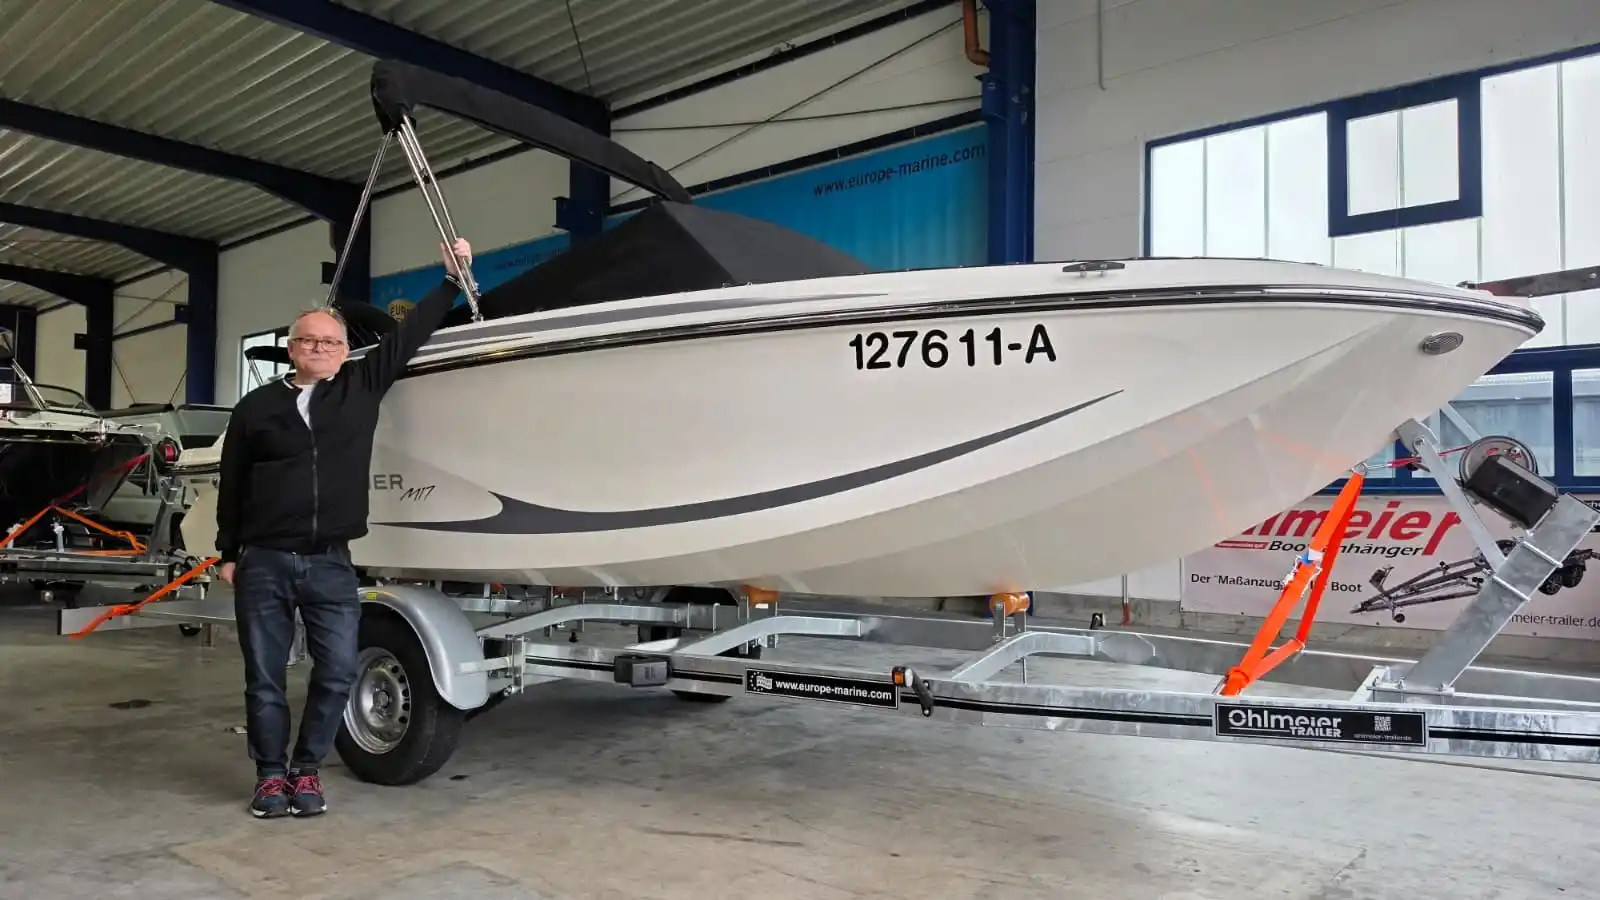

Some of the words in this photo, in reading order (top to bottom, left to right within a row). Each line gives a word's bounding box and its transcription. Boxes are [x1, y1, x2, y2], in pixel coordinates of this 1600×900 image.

[813, 143, 986, 196] www.europe-marine.com
[1191, 573, 1211, 584] Der
[1331, 581, 1362, 593] Boot
[775, 680, 892, 700] www.europe-marine.com
[1228, 709, 1342, 729] Ohlmeier
[1290, 726, 1342, 738] TRAILER
